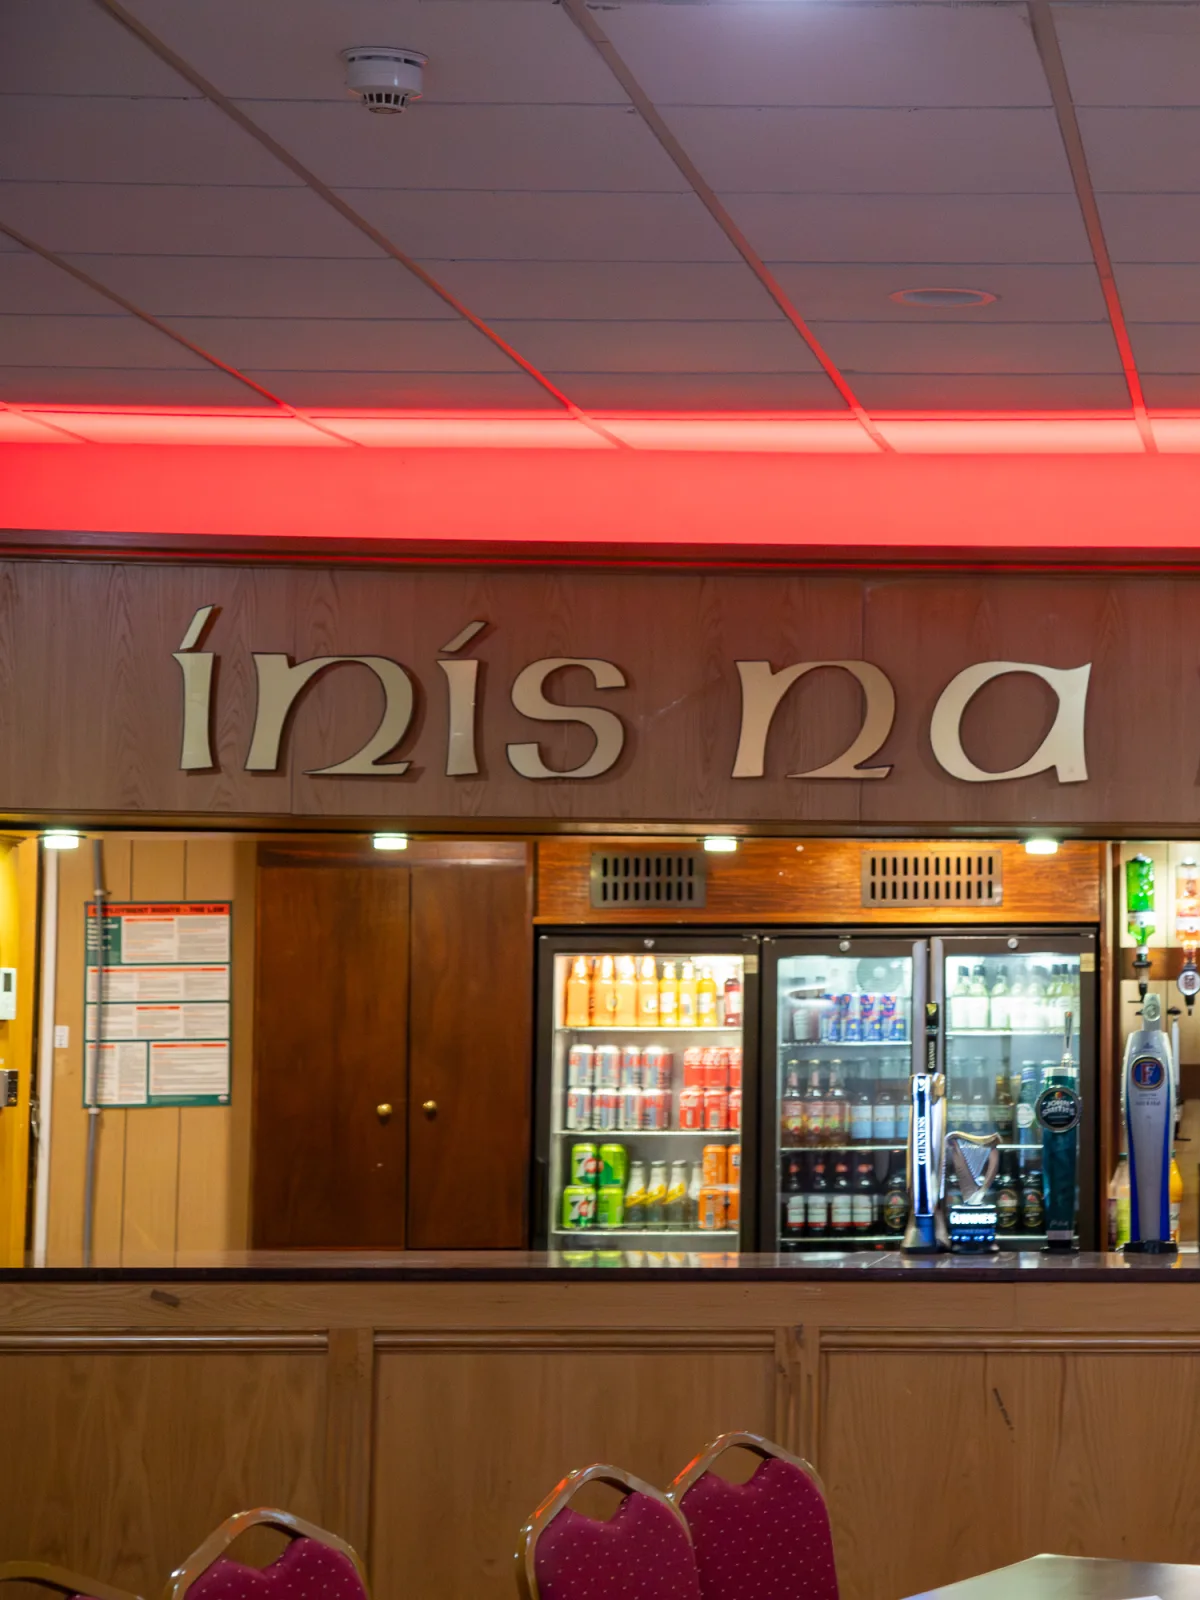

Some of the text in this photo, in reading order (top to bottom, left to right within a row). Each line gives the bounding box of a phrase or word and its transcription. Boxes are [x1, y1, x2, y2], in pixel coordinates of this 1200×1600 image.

[731, 658, 1093, 784] na
[917, 1116, 927, 1165] GUINNESS
[949, 1211, 998, 1225] GUINNESS
